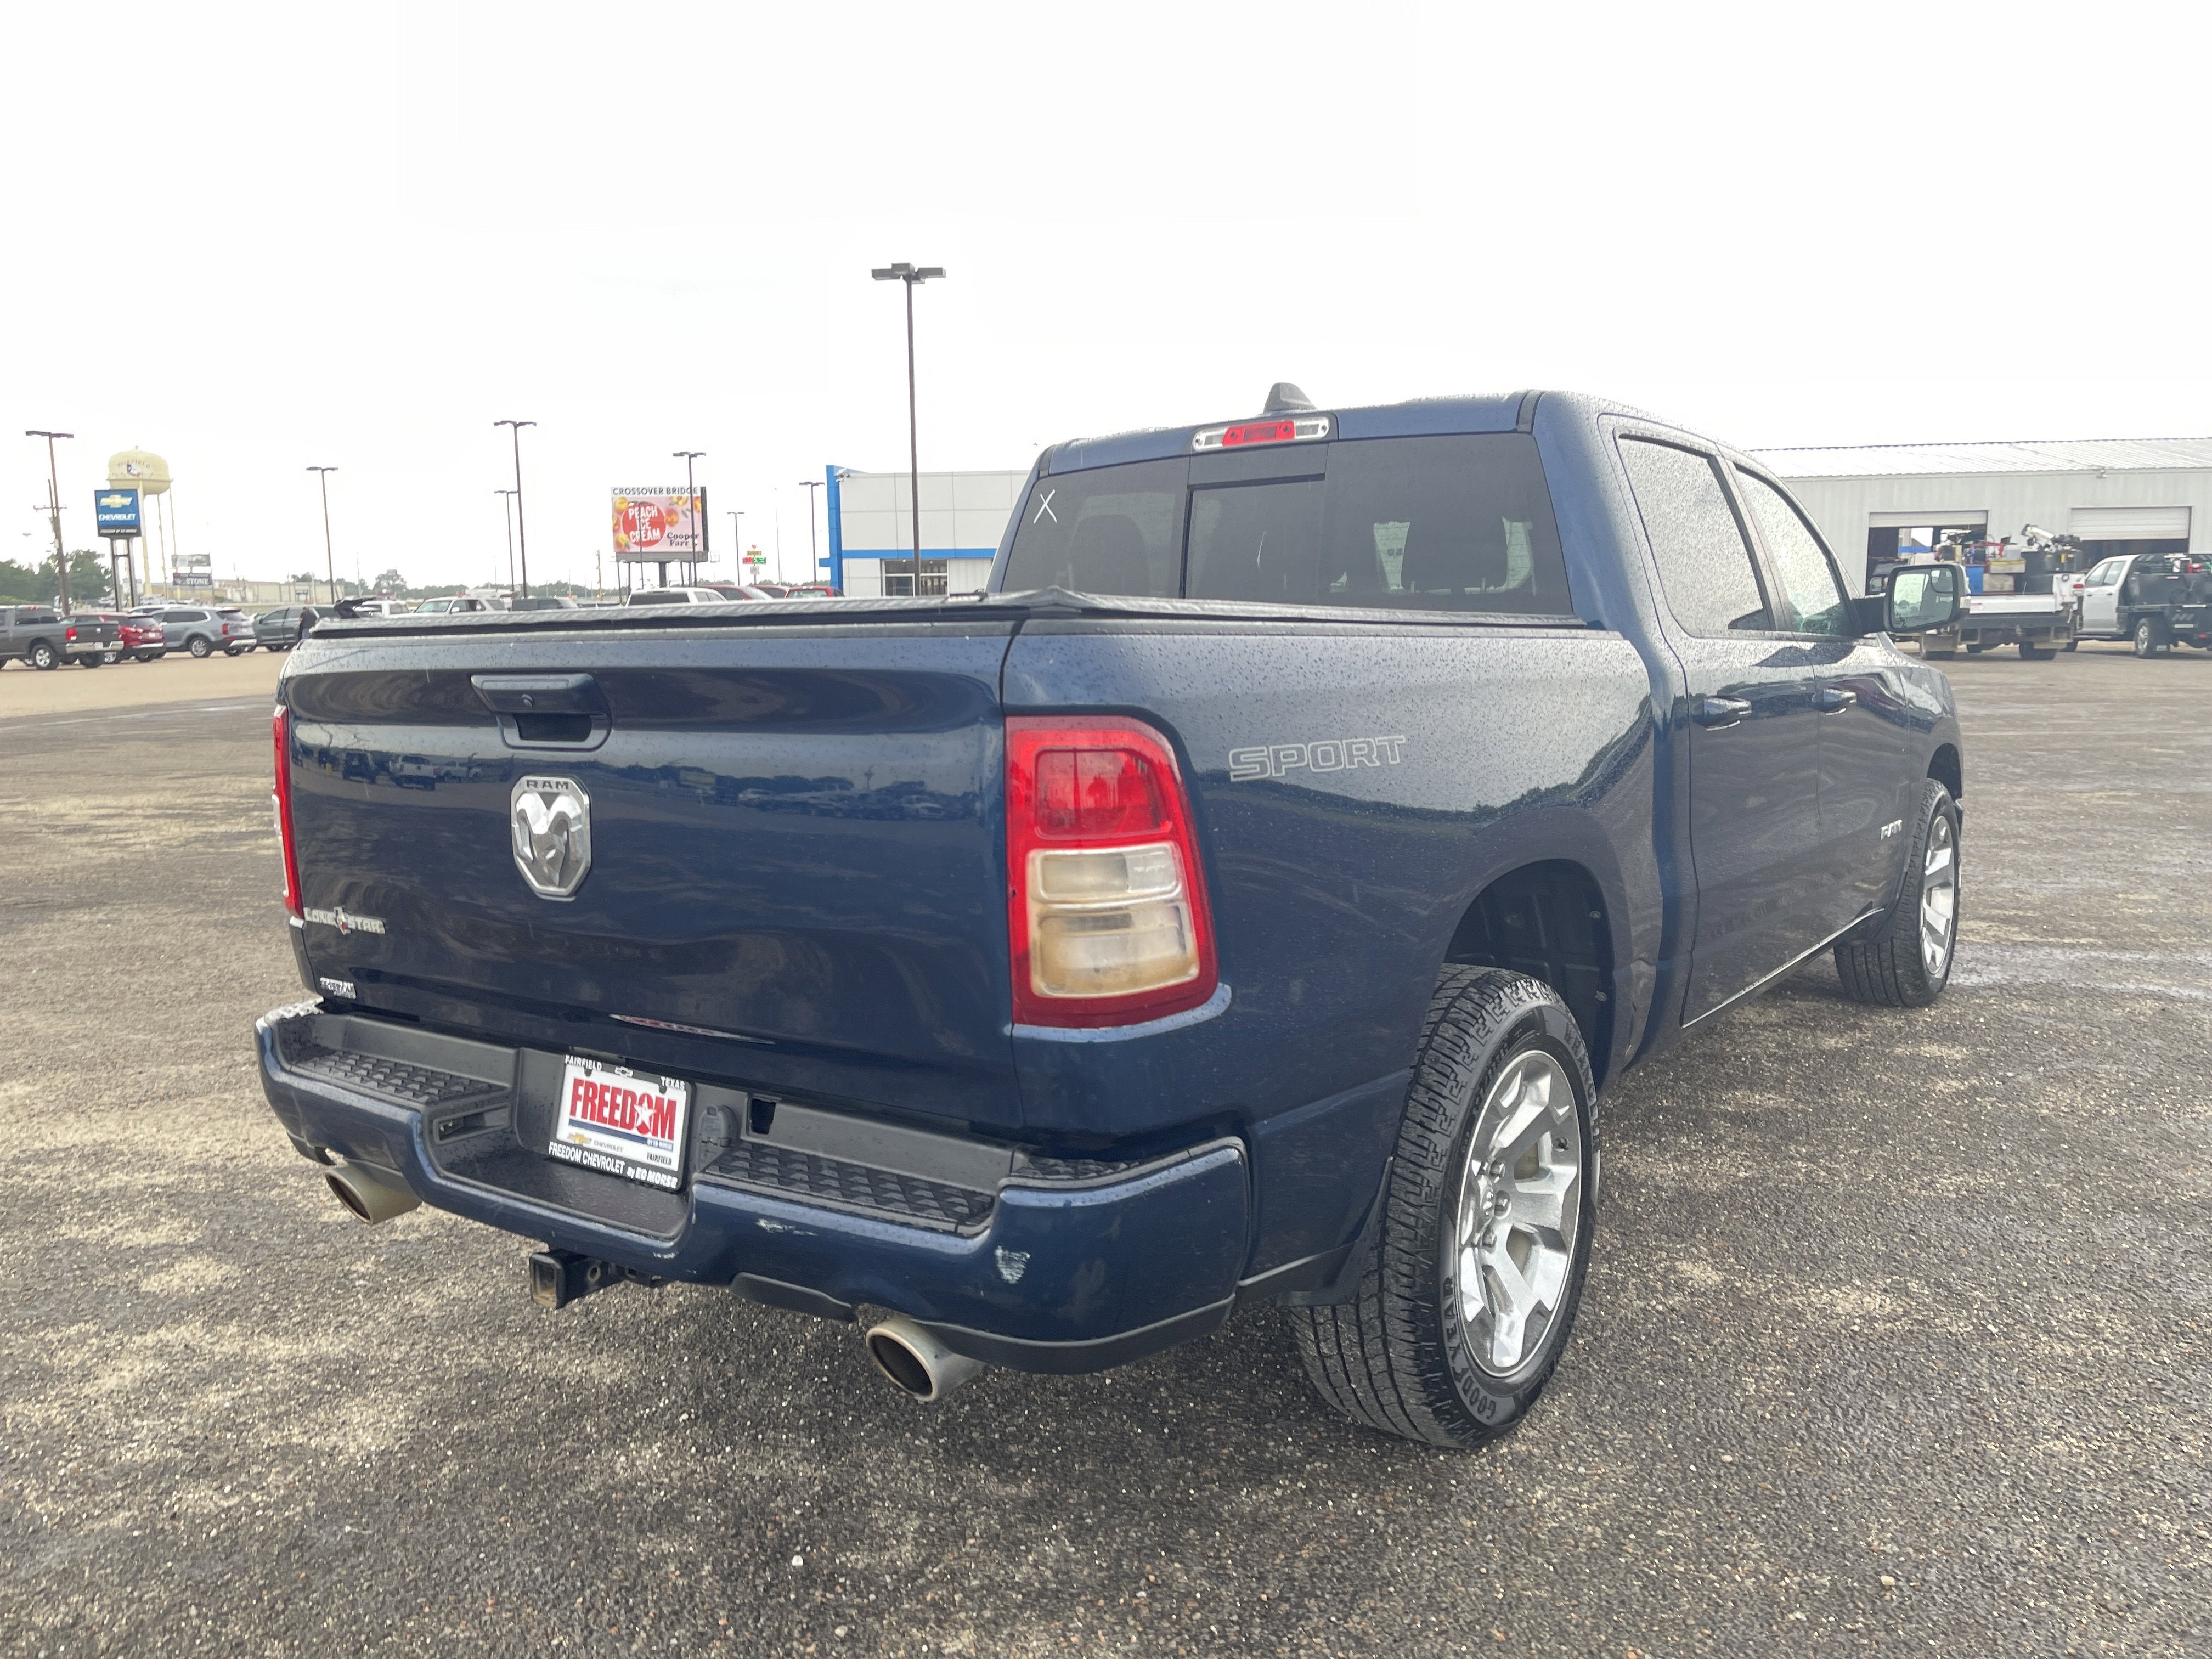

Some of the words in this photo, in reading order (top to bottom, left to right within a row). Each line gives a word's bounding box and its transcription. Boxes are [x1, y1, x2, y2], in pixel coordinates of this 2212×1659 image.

[612, 487, 663, 495] CROSSOVER
[666, 487, 698, 495] BRIDGE
[628, 505, 658, 520] PEACH
[636, 518, 651, 531] ICE
[629, 528, 661, 543] CREAM
[667, 532, 699, 540] Cooper
[1228, 735, 1406, 782] SPORT
[526, 778, 569, 791] RAM
[303, 907, 336, 926] LONE
[345, 913, 386, 935] STAR
[565, 1054, 602, 1071] FAIRFIELD
[661, 1076, 685, 1091] TEXAS
[569, 1077, 677, 1141] FREEDOM
[594, 1139, 624, 1153] CHEVROLET
[548, 1141, 582, 1163] FREEDOM
[582, 1150, 625, 1175] CHEVROLET
[635, 1167, 647, 1181] ED
[647, 1170, 678, 1189] MORSE
[646, 1152, 672, 1165] FAIRFIELD
[1442, 1276, 1497, 1420] GOODYEAR
